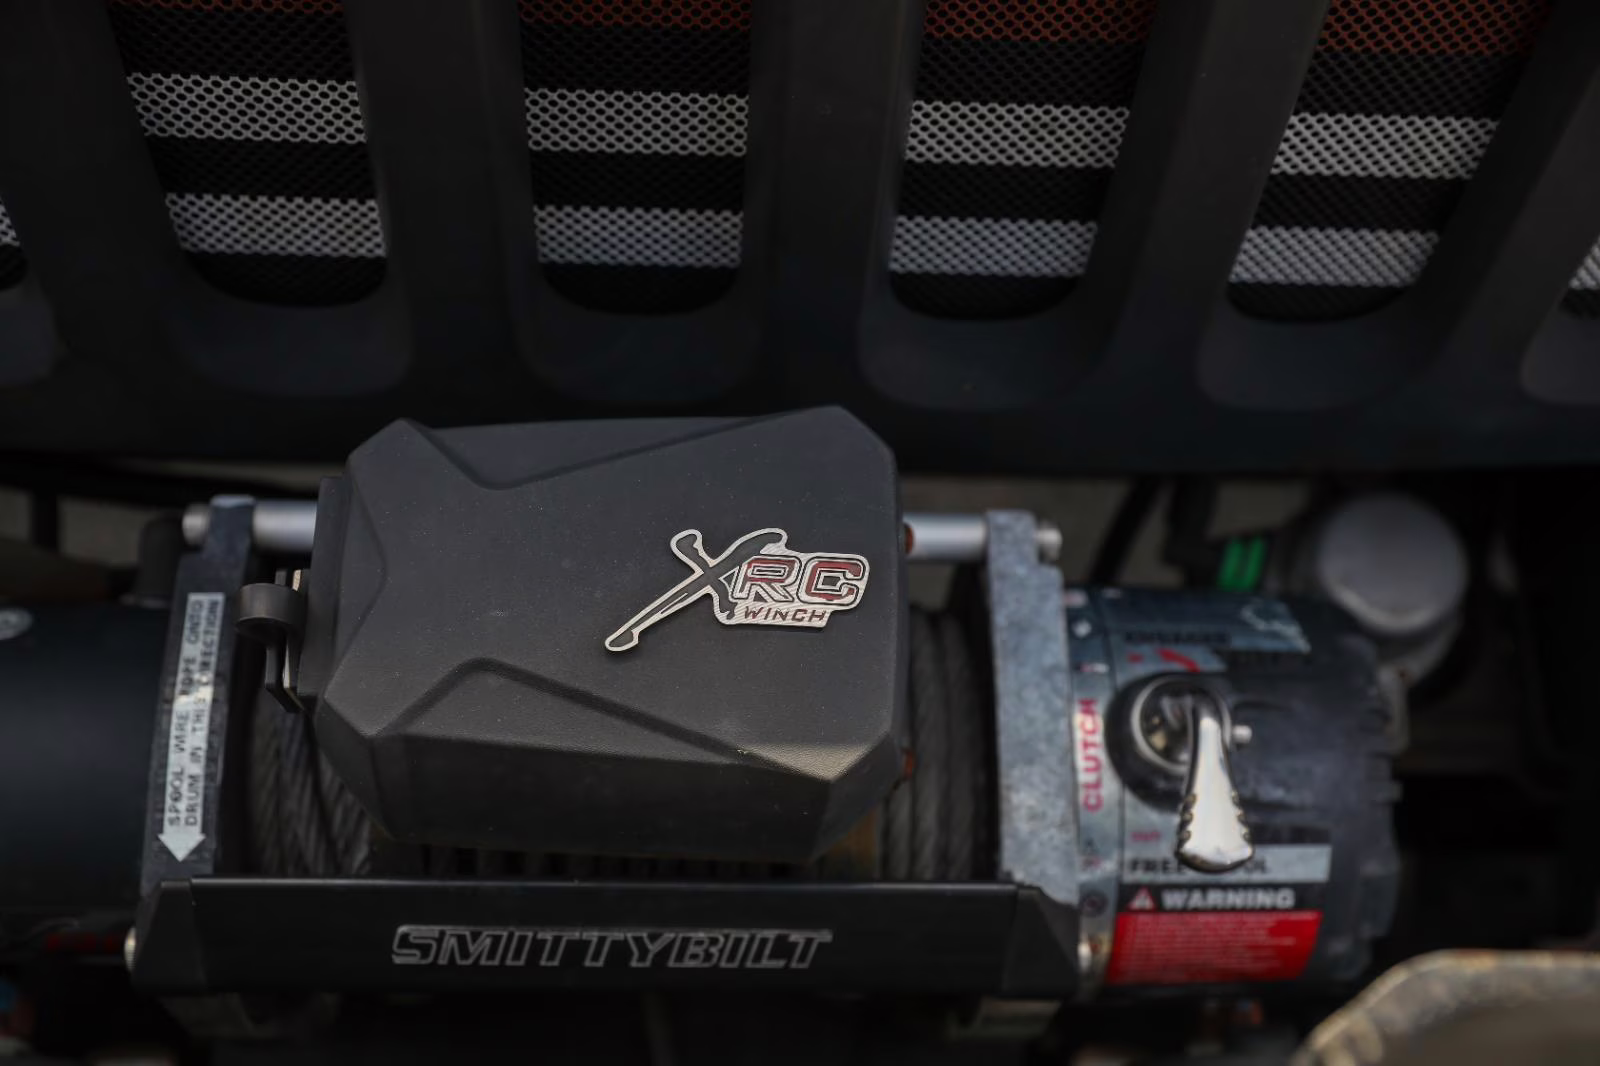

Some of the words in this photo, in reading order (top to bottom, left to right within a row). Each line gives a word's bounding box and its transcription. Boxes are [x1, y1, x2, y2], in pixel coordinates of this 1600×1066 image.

[743, 606, 826, 622] WINCH
[172, 712, 189, 753] WIRE
[192, 696, 207, 734] THIS
[189, 746, 203, 764] IN
[1078, 698, 1104, 812] CLUTCH
[167, 766, 183, 827] SPOOL
[184, 774, 201, 827] DRUM
[1161, 889, 1296, 909] WARNING
[392, 925, 833, 969] SMITTYBILT
